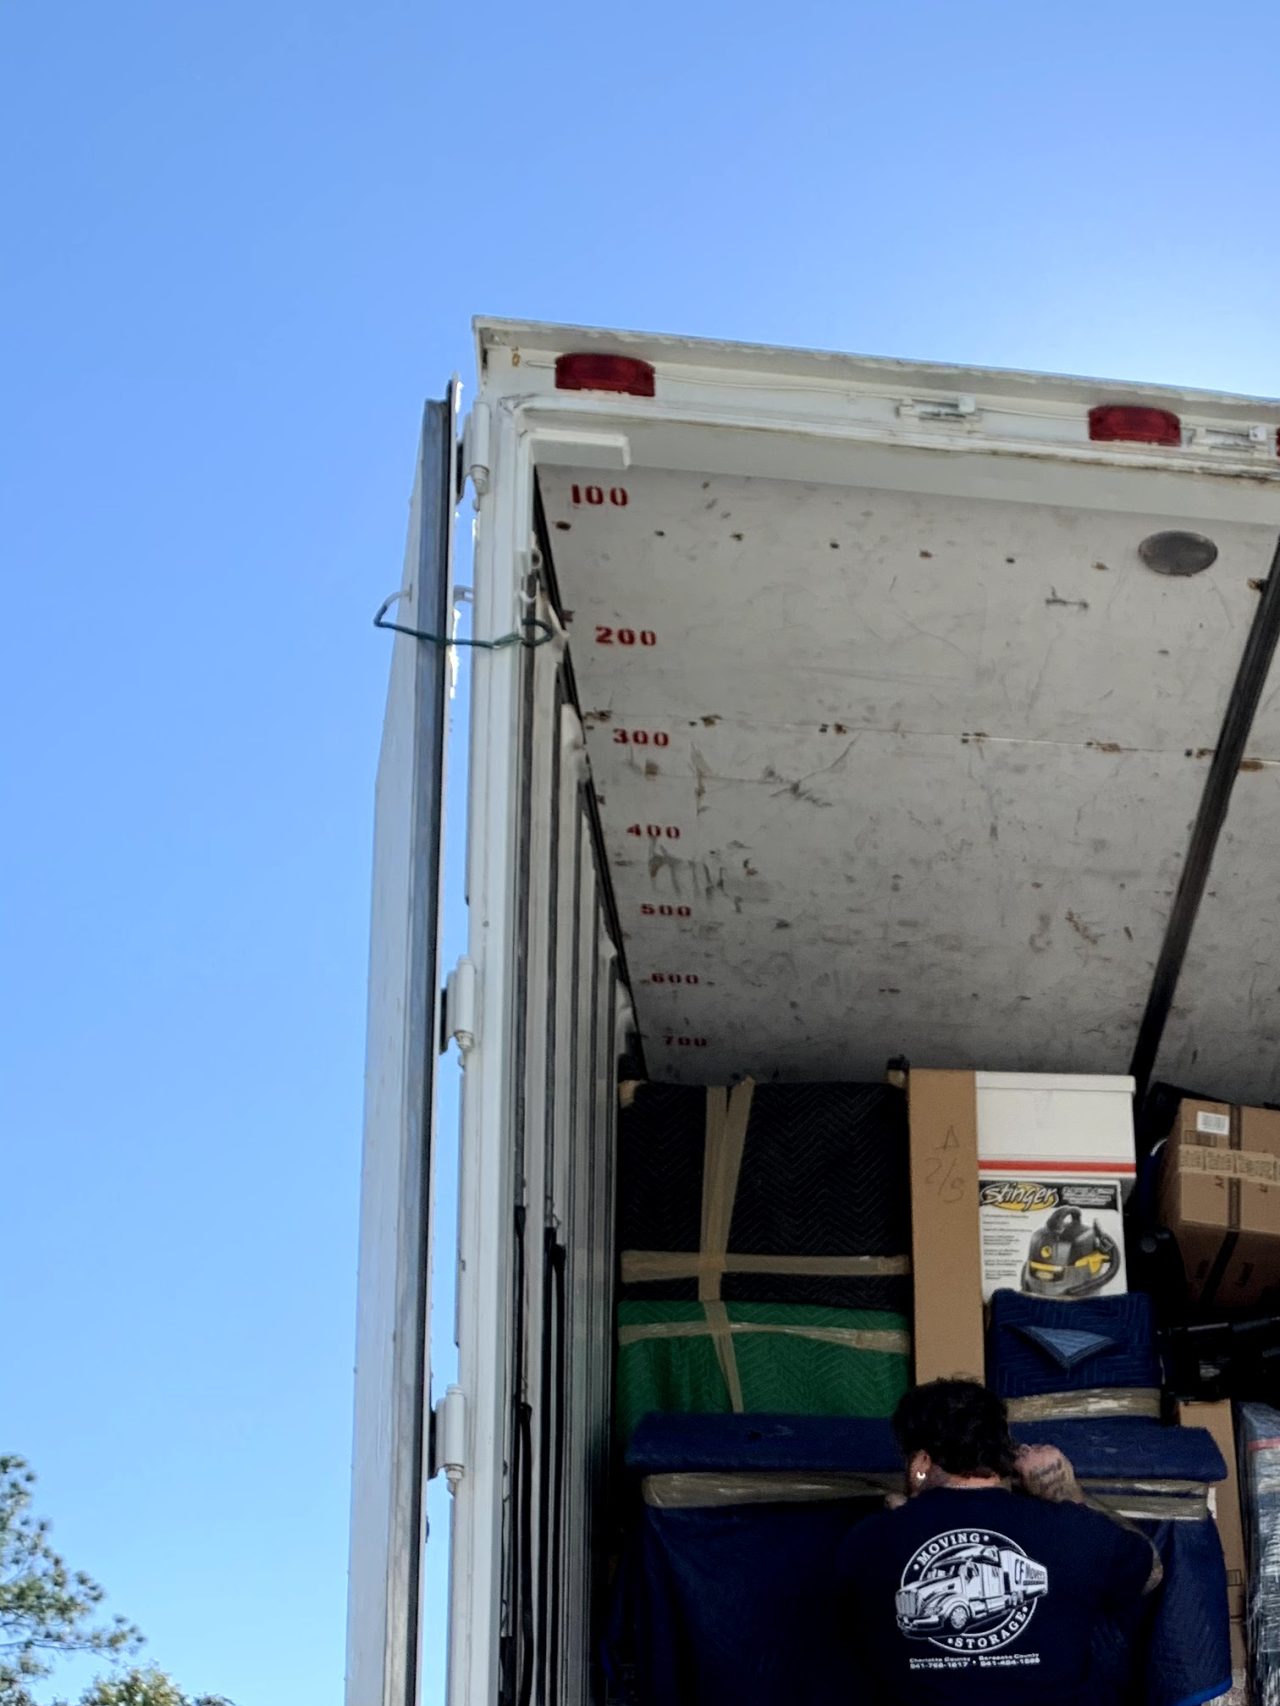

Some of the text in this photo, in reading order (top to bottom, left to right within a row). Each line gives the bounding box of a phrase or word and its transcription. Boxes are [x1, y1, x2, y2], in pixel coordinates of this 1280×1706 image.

[571, 484, 629, 507] 100
[595, 625, 657, 646] 200
[613, 728, 669, 747] 300
[626, 823, 680, 839] 400
[641, 903, 691, 916] 500
[651, 972, 699, 985] 600
[662, 1035, 707, 1047] 700
[981, 1182, 1056, 1212] Stinger
[916, 1532, 981, 1565] MOVING
[954, 1608, 1027, 1649] STORAGE
